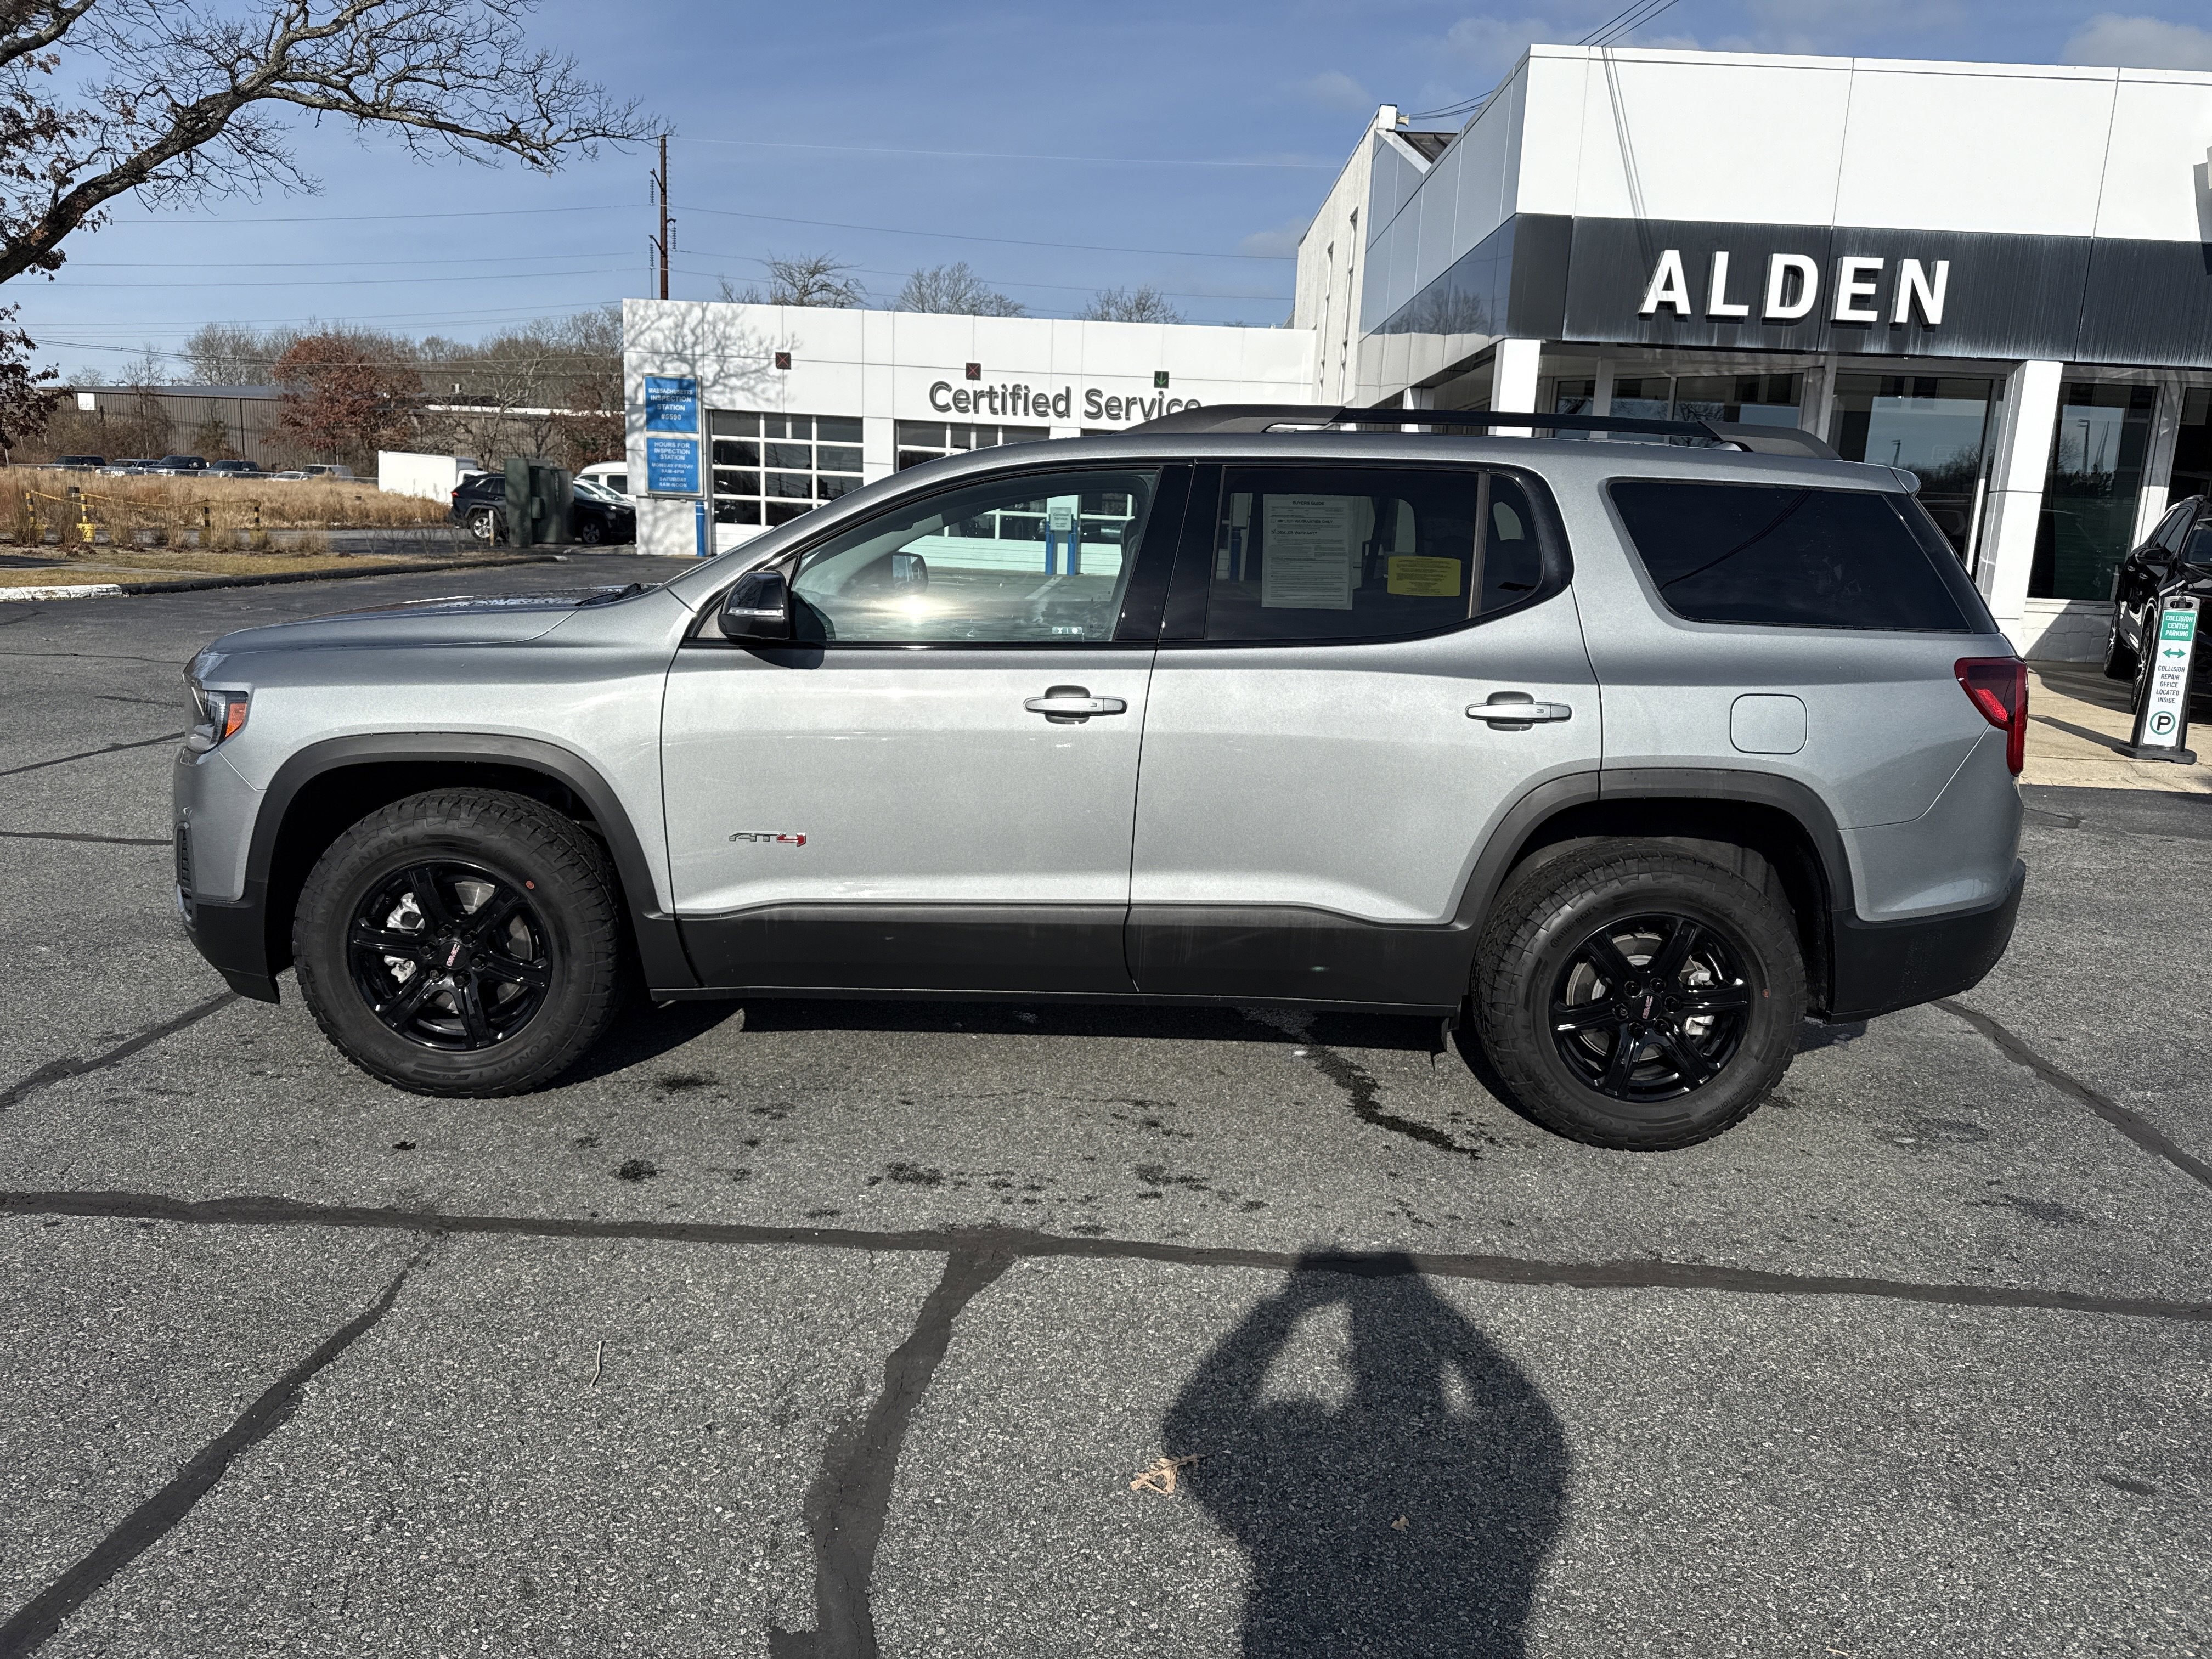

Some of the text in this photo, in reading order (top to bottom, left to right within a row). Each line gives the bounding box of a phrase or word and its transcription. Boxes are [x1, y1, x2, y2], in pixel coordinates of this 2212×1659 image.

[1638, 249, 1949, 325] ALDEN
[929, 381, 1071, 418] Certified
[2157, 715, 2171, 731] P
[1550, 909, 1593, 948] Continental
[1642, 995, 1654, 1019] GMC
[1719, 1082, 1750, 1111] TRACTION
